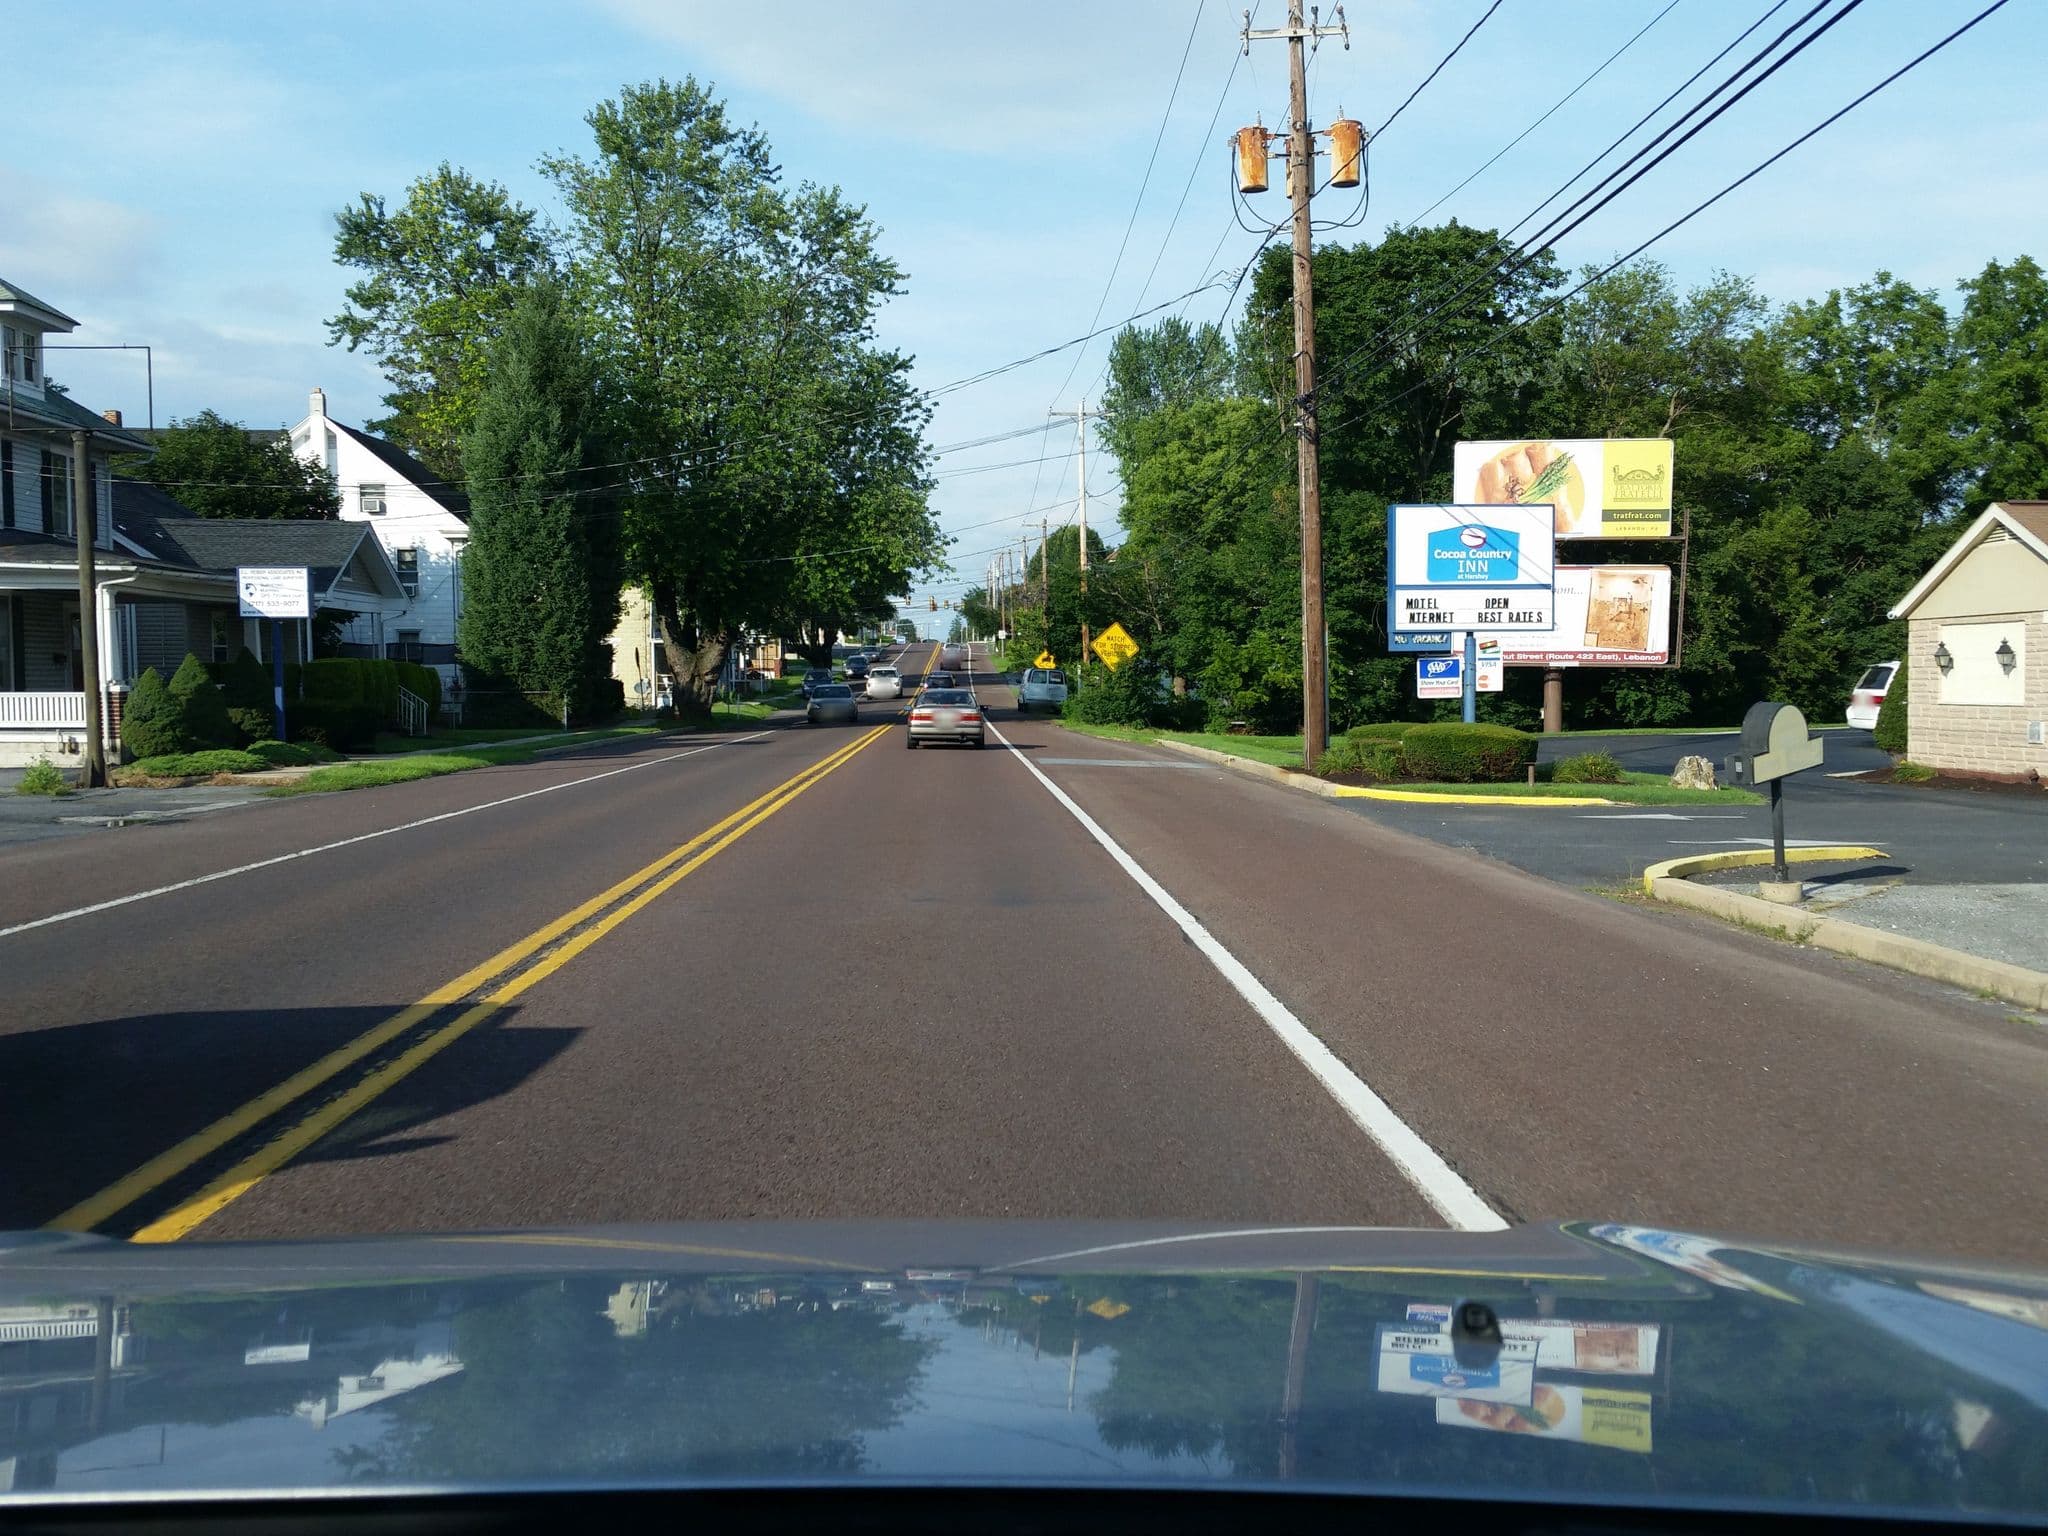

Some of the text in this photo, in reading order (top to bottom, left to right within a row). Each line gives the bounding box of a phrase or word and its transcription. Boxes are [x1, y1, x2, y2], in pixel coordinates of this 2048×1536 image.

[1613, 511, 1662, 519] tratfrat.com
[1433, 549, 1512, 561] Cocoa Country
[1457, 560, 1489, 573] INN
[1405, 597, 1510, 609] MOTEL OPEN
[1408, 611, 1543, 624] NTERNET BEST RATES
[1106, 635, 1125, 643] WATCH
[1110, 642, 1137, 651] STOPPED
[1545, 652, 1574, 661] (Route
[1596, 653, 1622, 662] East),
[1623, 653, 1662, 661] Lebanon
